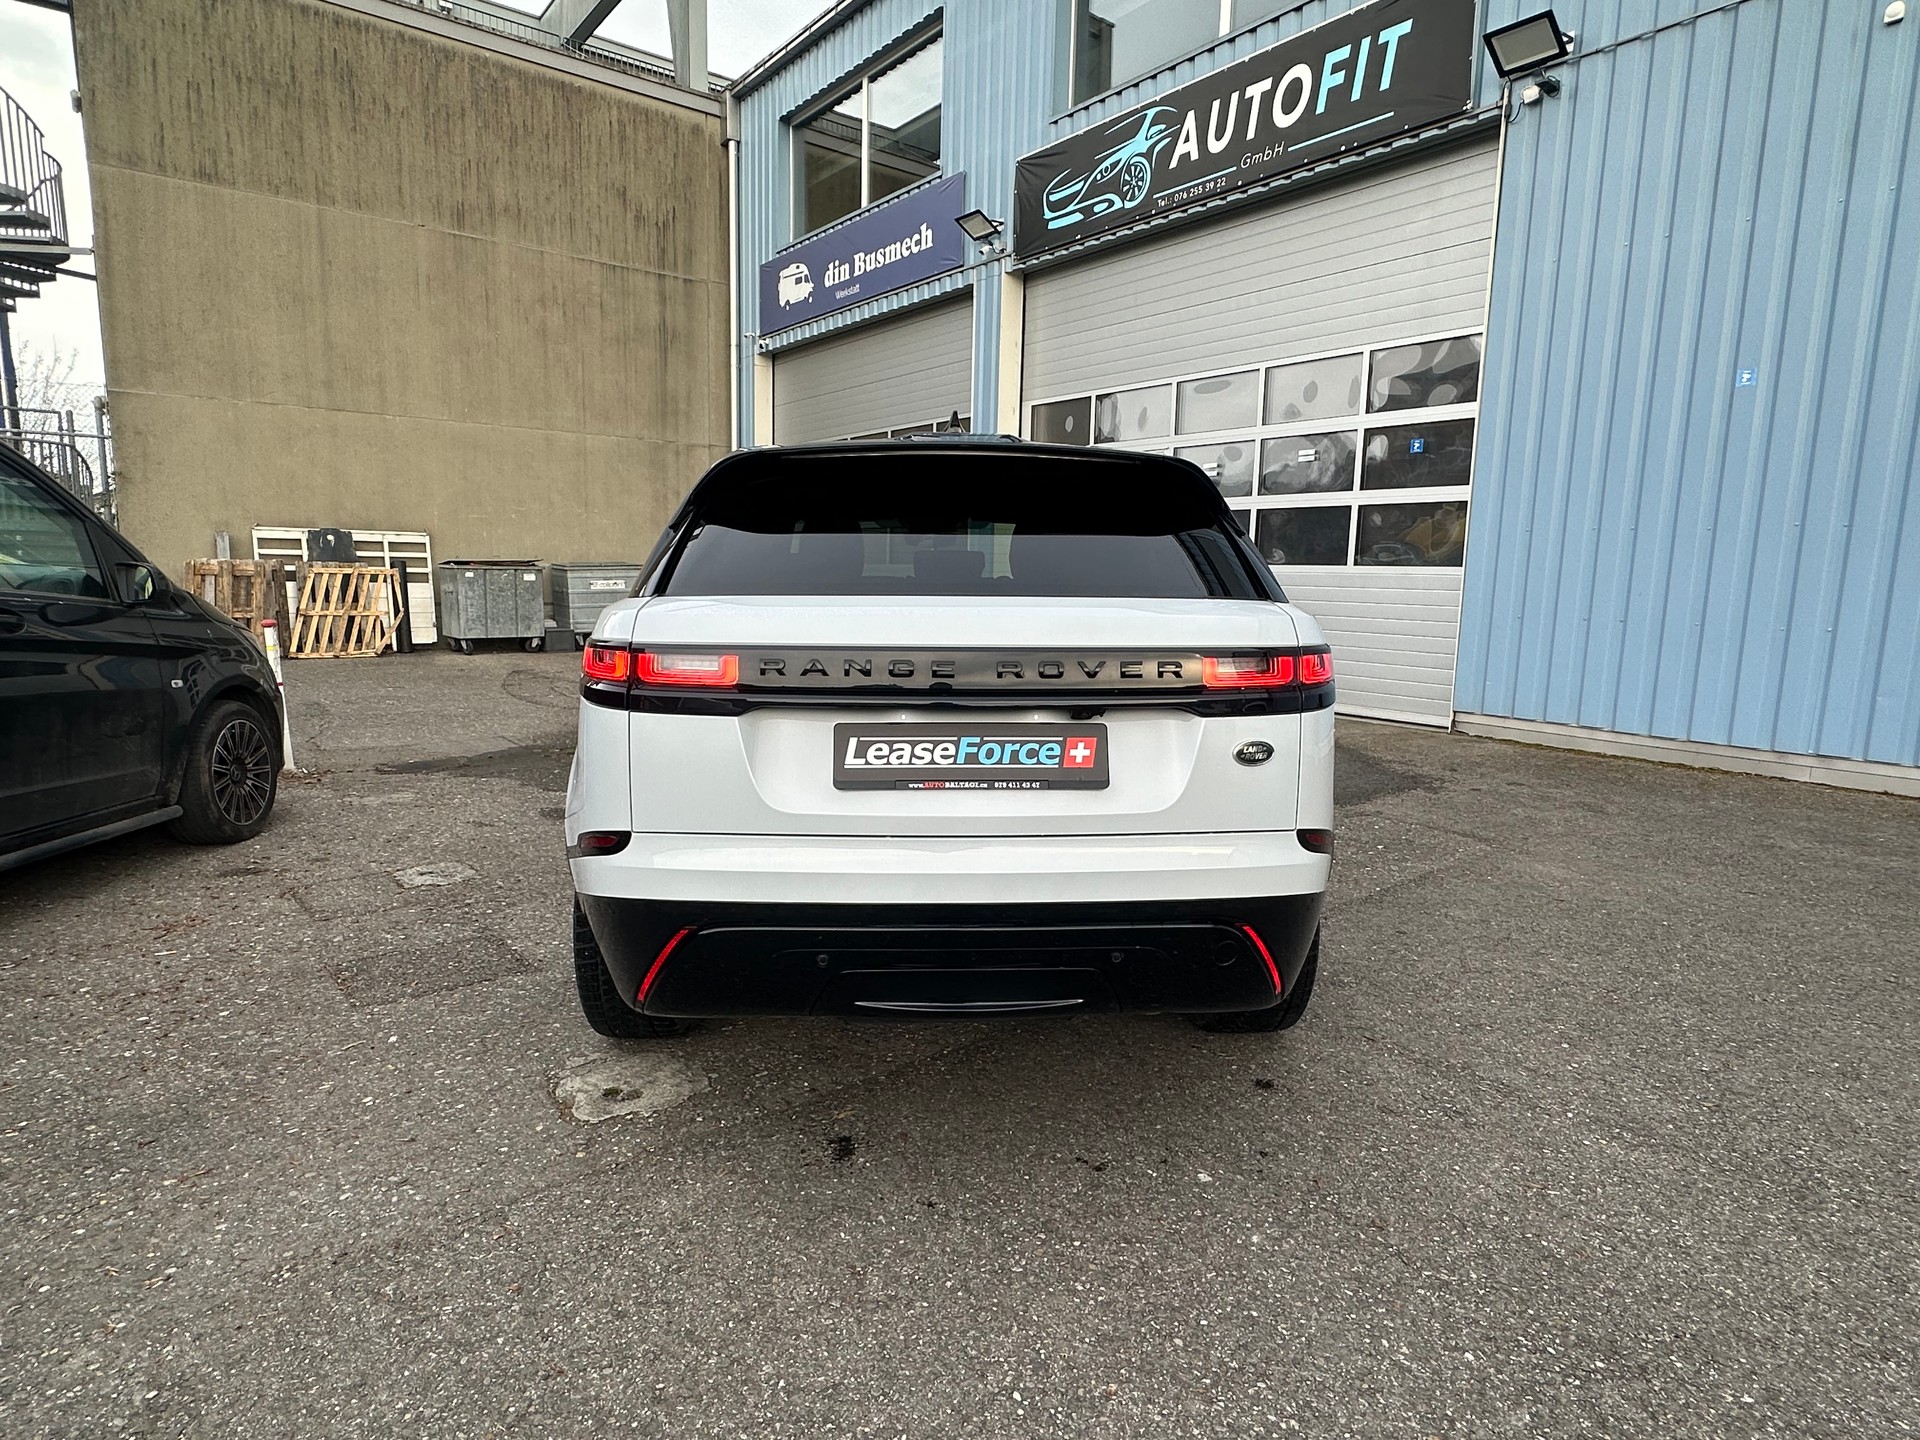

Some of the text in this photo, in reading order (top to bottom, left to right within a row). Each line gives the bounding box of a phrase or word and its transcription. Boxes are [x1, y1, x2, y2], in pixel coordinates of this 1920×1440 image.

[1168, 18, 1414, 169] AUTOFIT
[1240, 141, 1285, 169] GmbH
[1174, 191, 1188, 202] 076
[1189, 185, 1203, 197] 255
[1205, 181, 1215, 192] 39
[1216, 177, 1226, 188] 22
[824, 222, 934, 288] din Busmech
[835, 283, 860, 300] Werkstatt
[759, 658, 1185, 680] RANGE ROVER
[844, 736, 1061, 765] LeaseForce
[1243, 745, 1263, 753] LAND
